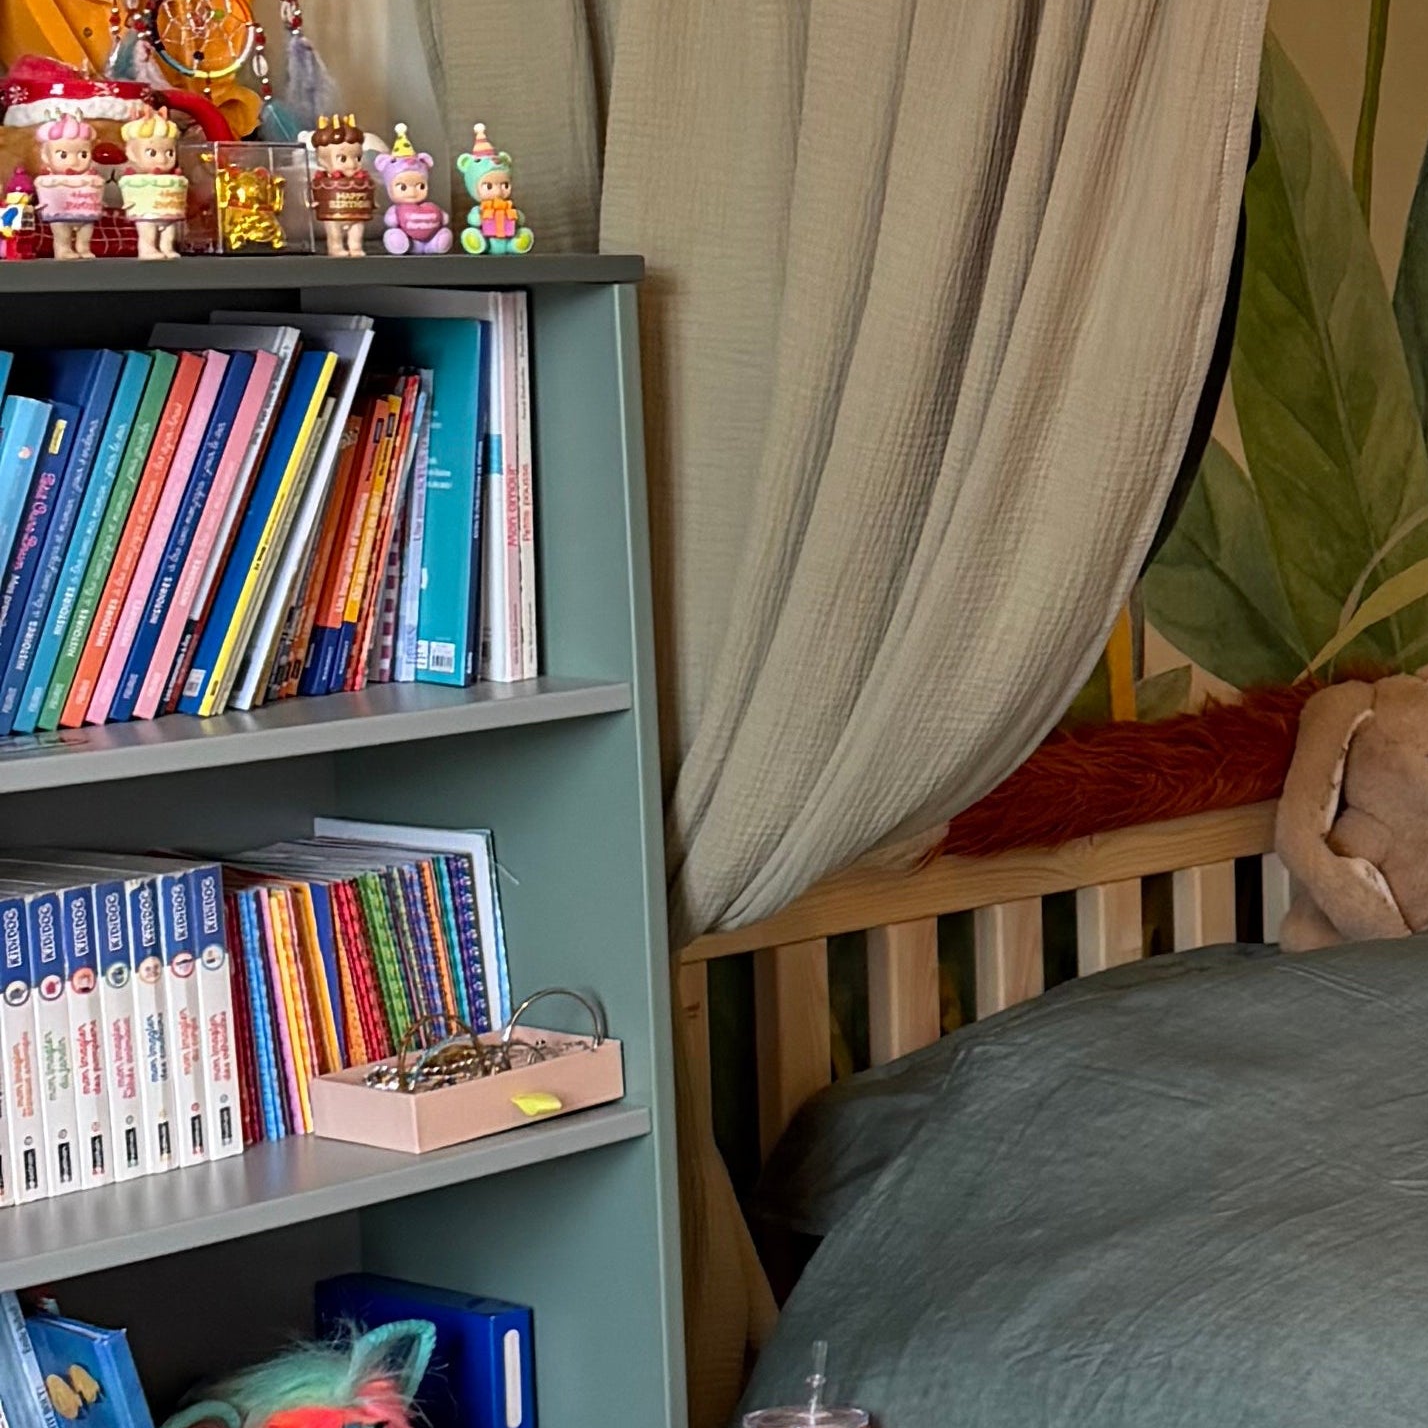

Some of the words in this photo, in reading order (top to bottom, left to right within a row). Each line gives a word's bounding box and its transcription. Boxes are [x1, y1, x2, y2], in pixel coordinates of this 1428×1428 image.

[505, 463, 516, 511] amour
[506, 516, 517, 546] Mon
[52, 584, 76, 637] HISTOIRES
[93, 596, 119, 648] HISTOIRES
[148, 574, 173, 625] HISTOIRES
[14, 619, 38, 671] HISTOIRES
[65, 606, 90, 658] HISTOIRES
